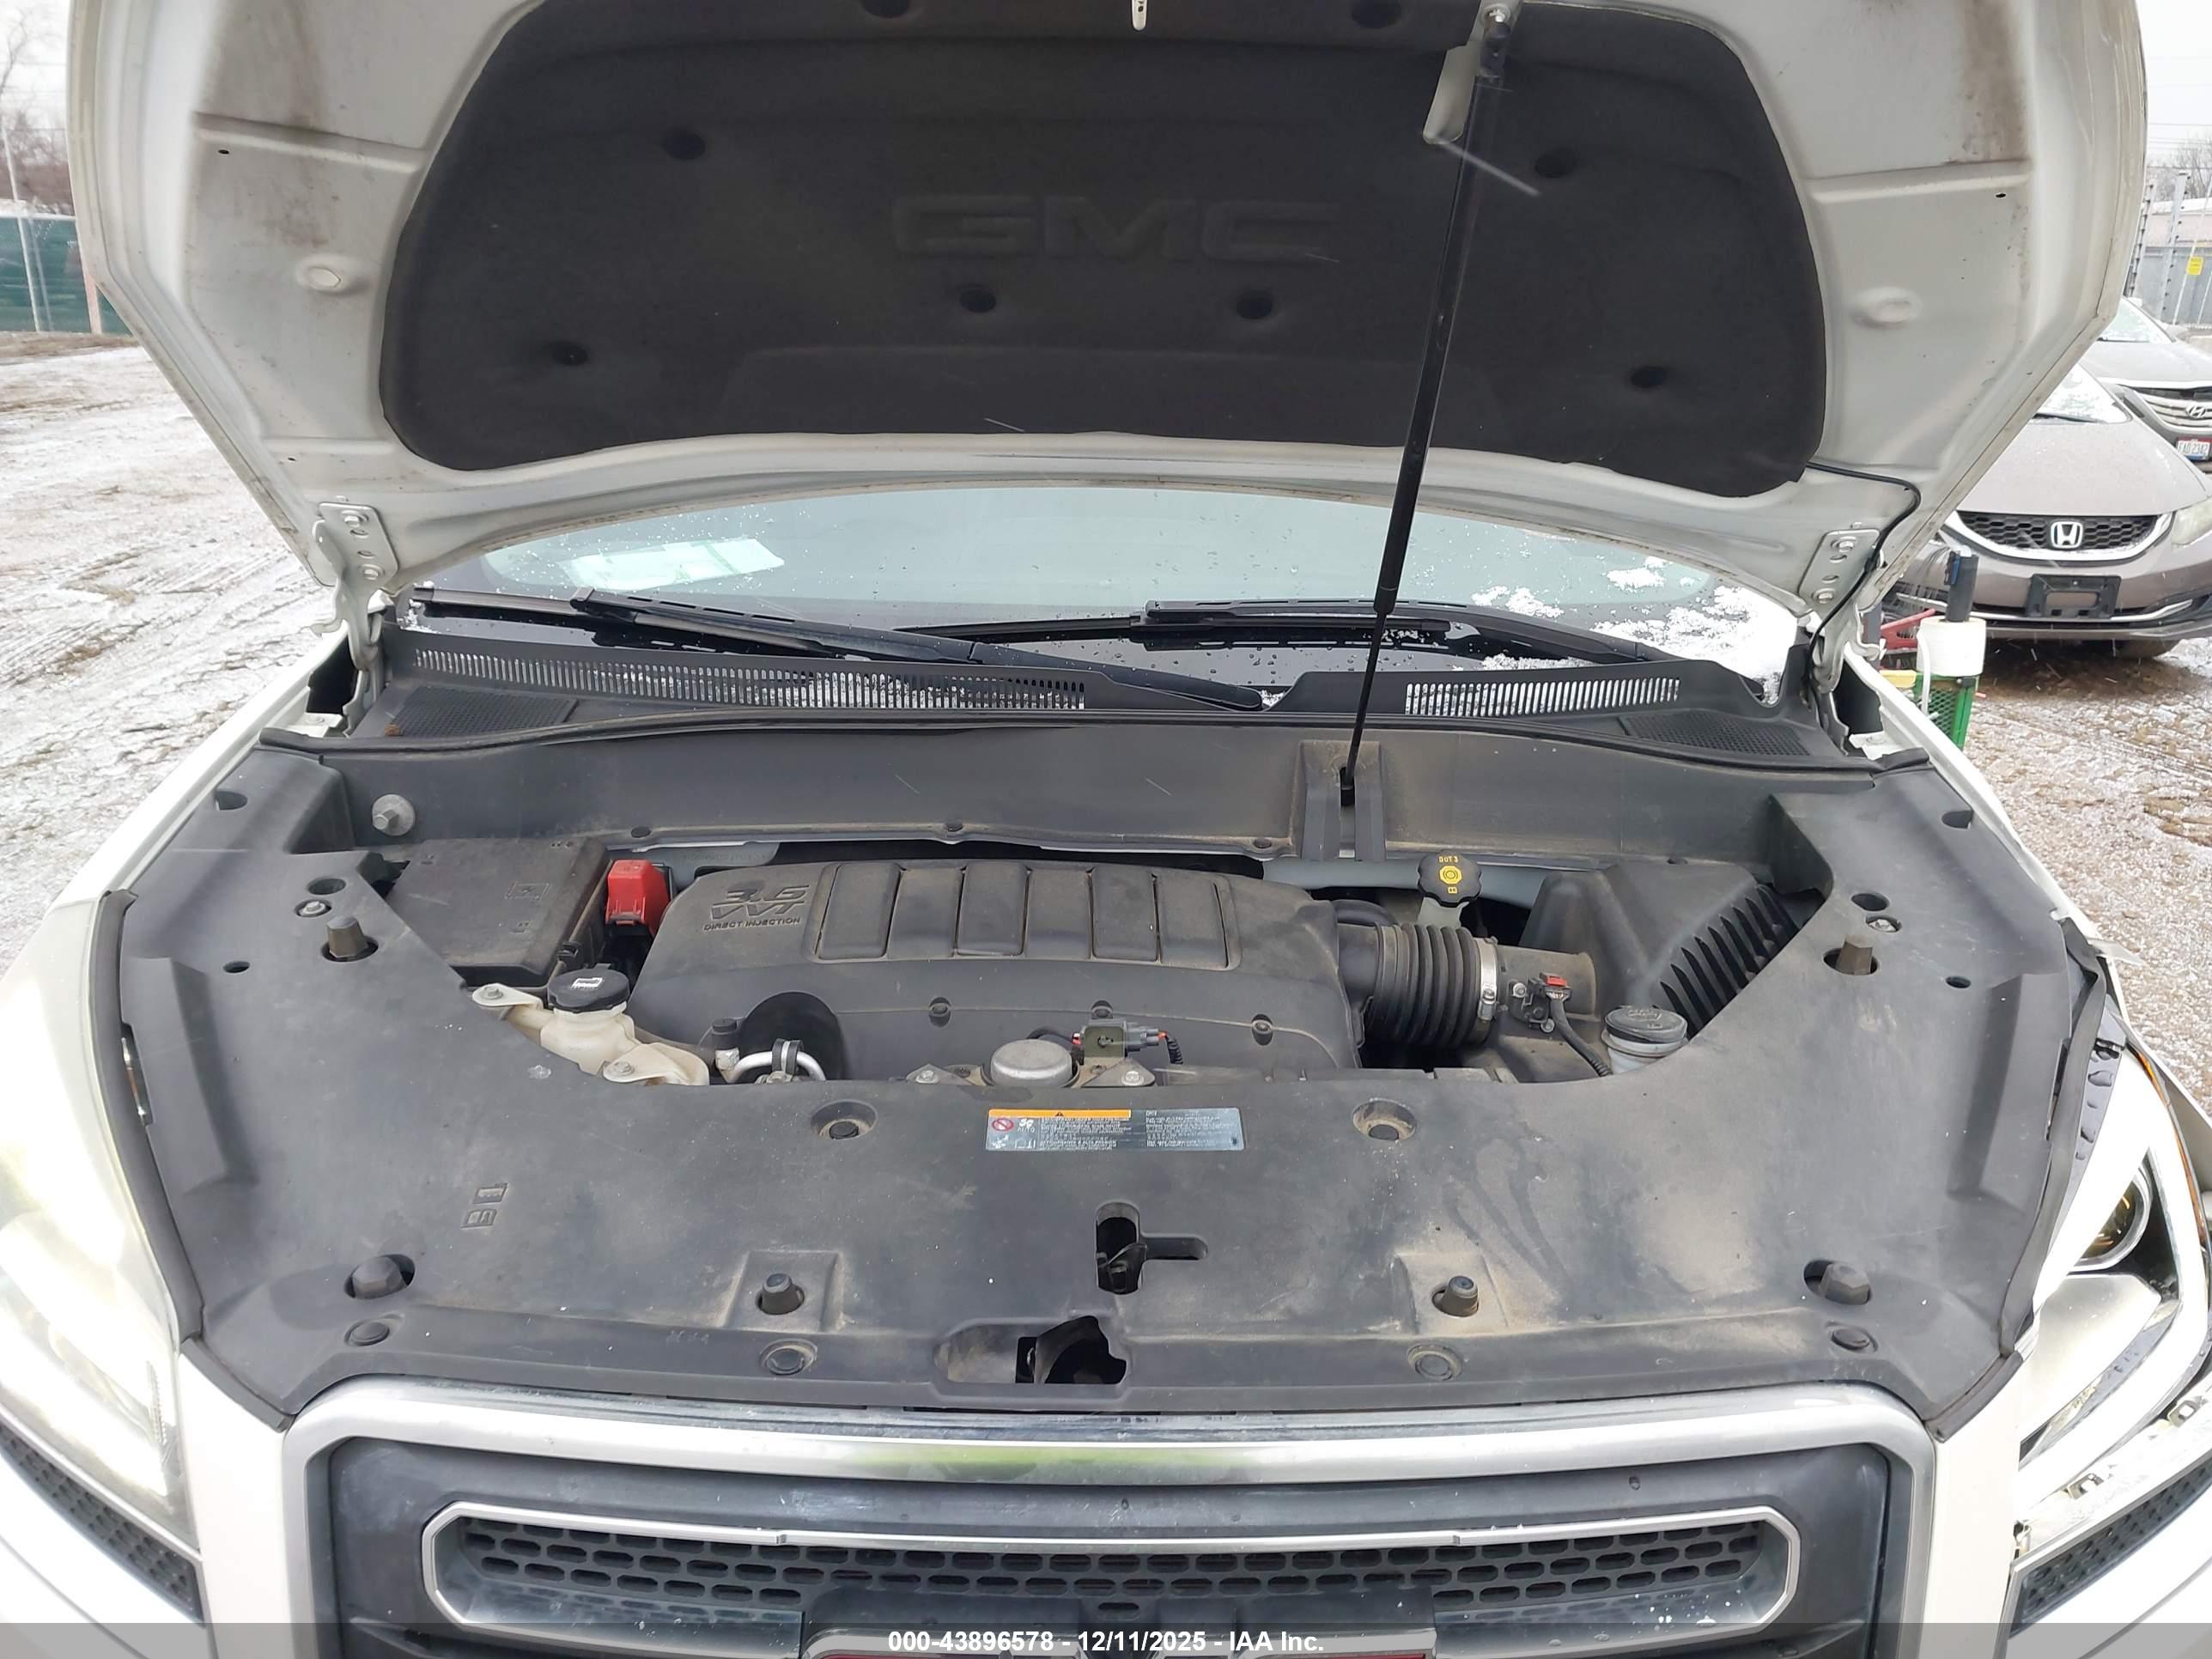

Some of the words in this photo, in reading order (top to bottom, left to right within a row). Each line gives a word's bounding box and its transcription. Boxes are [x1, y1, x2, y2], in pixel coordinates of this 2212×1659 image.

[891, 194, 1340, 261] GMC
[703, 921, 743, 931] DIRECT
[744, 916, 800, 927] INJECTION
